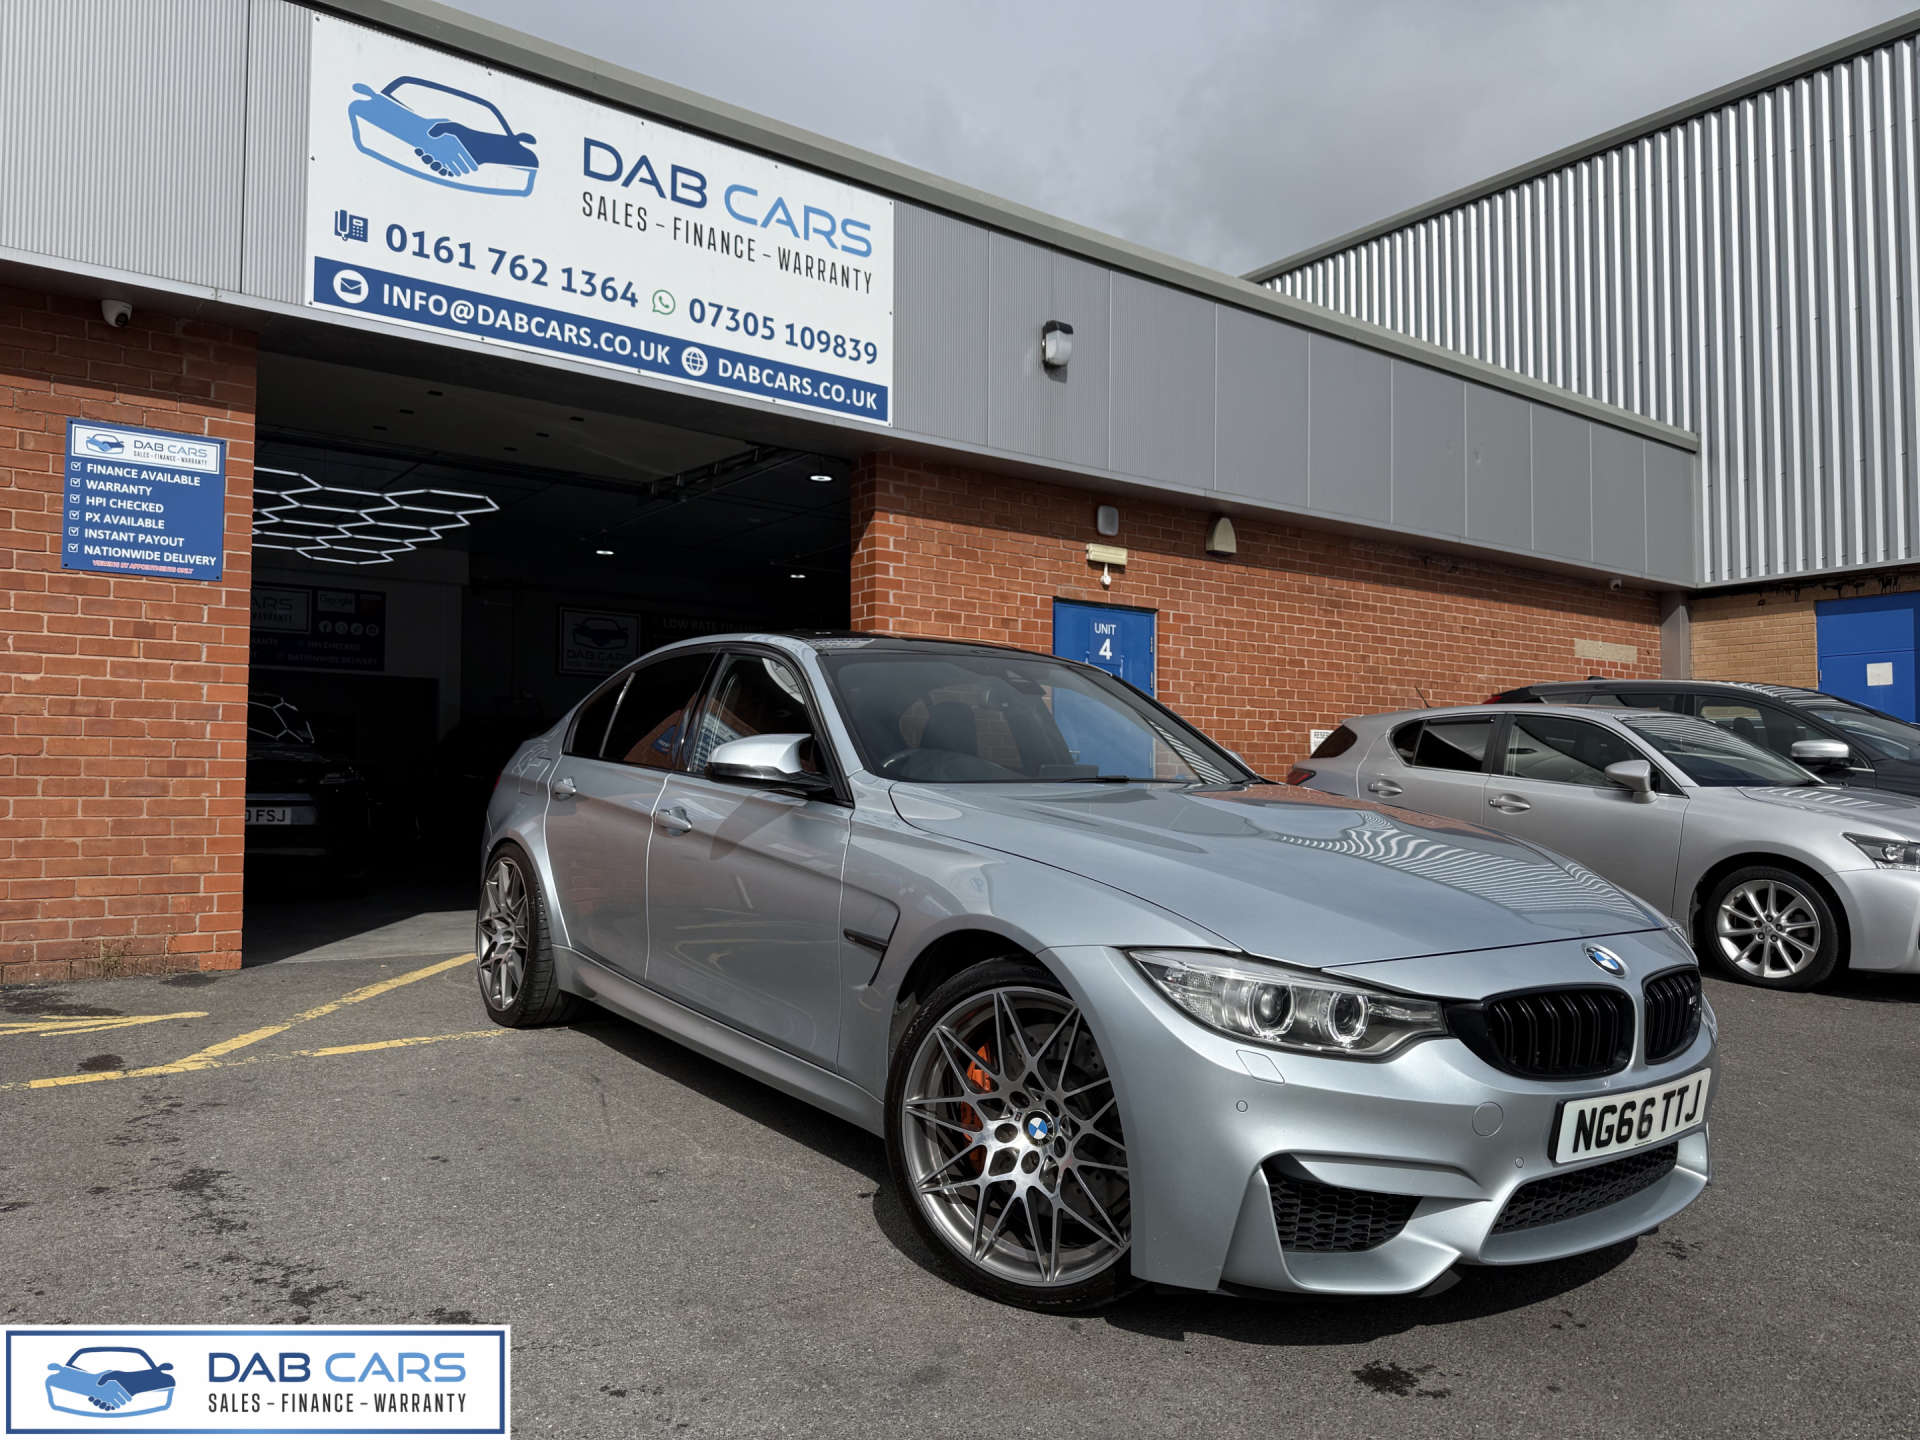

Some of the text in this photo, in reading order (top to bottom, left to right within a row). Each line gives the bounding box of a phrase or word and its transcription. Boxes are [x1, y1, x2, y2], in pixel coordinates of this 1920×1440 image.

[583, 137, 872, 258] DAB CARS
[582, 191, 648, 231] SALES
[672, 216, 756, 262] FINANCE
[777, 246, 873, 294] WARRANTY
[385, 223, 638, 307] 0161 762 1364
[382, 282, 671, 366] INFO@DABCARS.CO.UK
[689, 298, 878, 365] 07305 109839
[718, 358, 878, 410] DABCARS.CO.UK
[134, 440, 208, 458] DAB CARS
[86, 464, 200, 486] FINANCE AVAILABLE
[86, 480, 152, 496] WARRANTY
[86, 496, 164, 513] HPI CHECKED
[86, 512, 164, 530] PX AVAILABLE
[84, 528, 184, 547] INSTANT PAYOUT
[84, 545, 216, 566] NATIONWIDE DELIVERY
[252, 596, 294, 610] ARS
[1094, 622, 1116, 636] UNIT
[1098, 638, 1112, 660] 4
[256, 809, 286, 822] FSJ
[1572, 1080, 1702, 1153] NG66 TTJ
